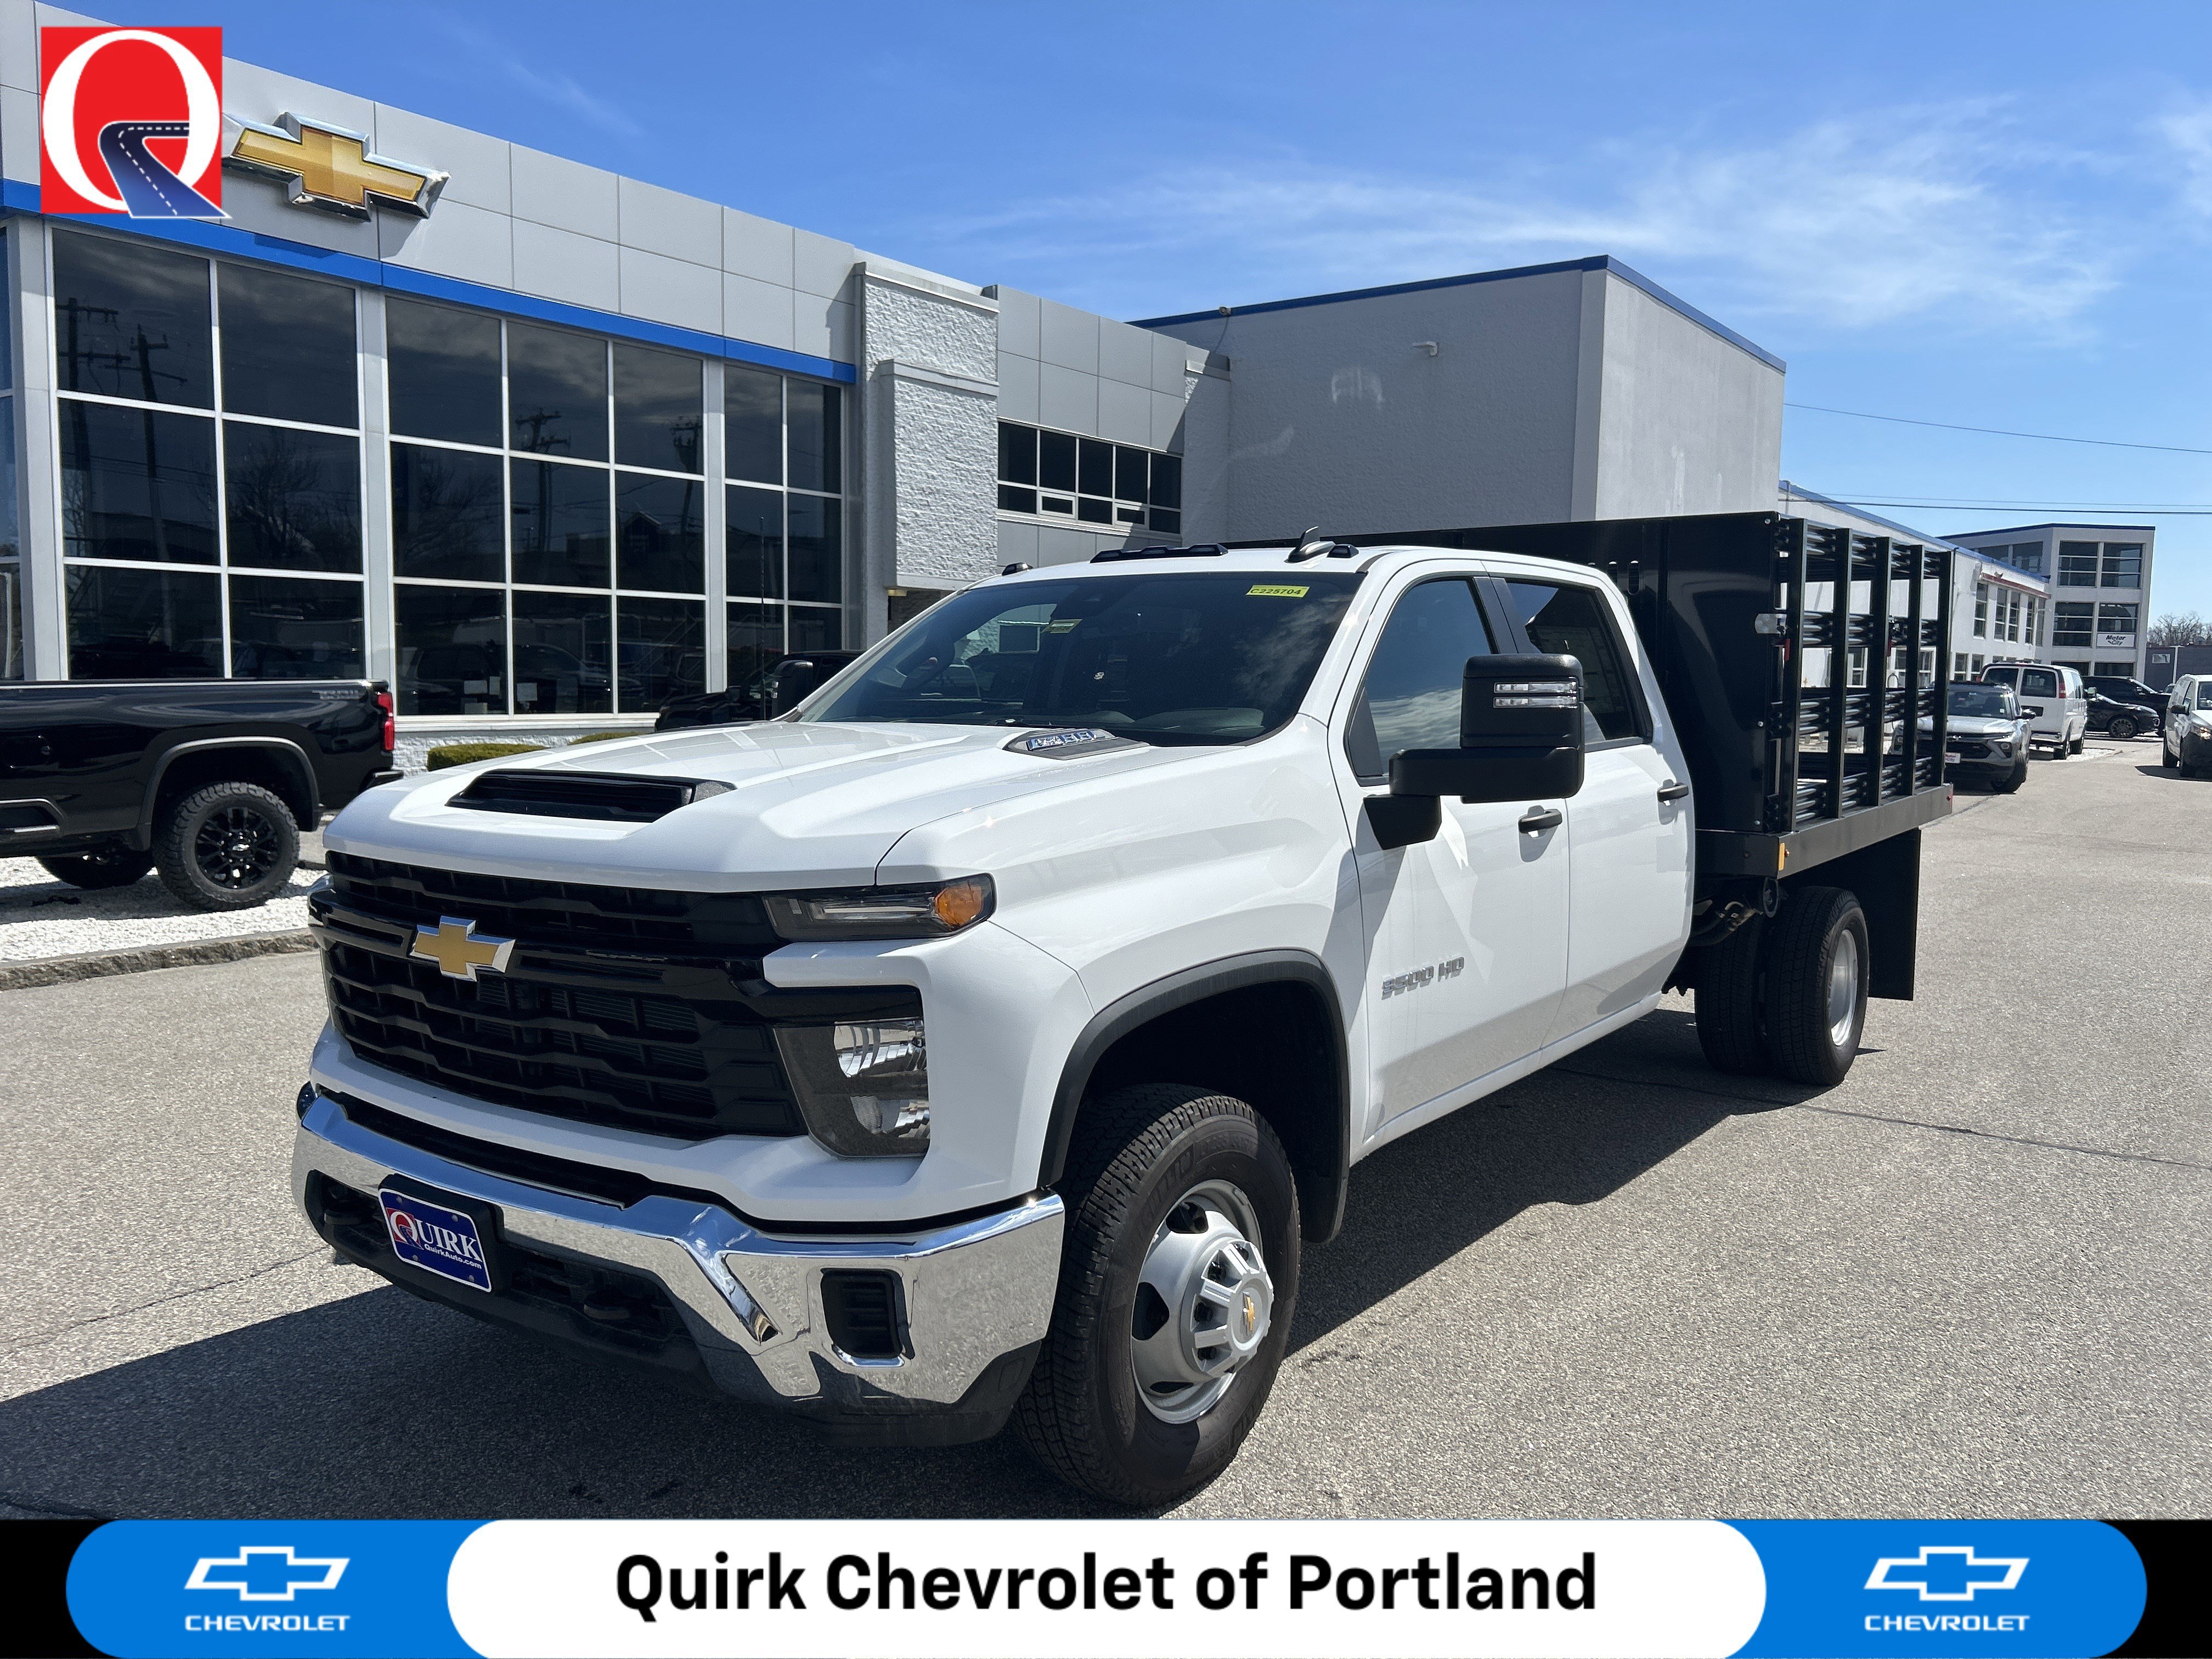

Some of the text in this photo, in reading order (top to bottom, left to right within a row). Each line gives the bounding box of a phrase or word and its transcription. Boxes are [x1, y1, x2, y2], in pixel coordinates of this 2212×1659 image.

[1382, 956, 1465, 995] 3500 HD
[390, 1210, 483, 1263] QUIRK
[424, 1243, 482, 1269] QuirkAuto.com
